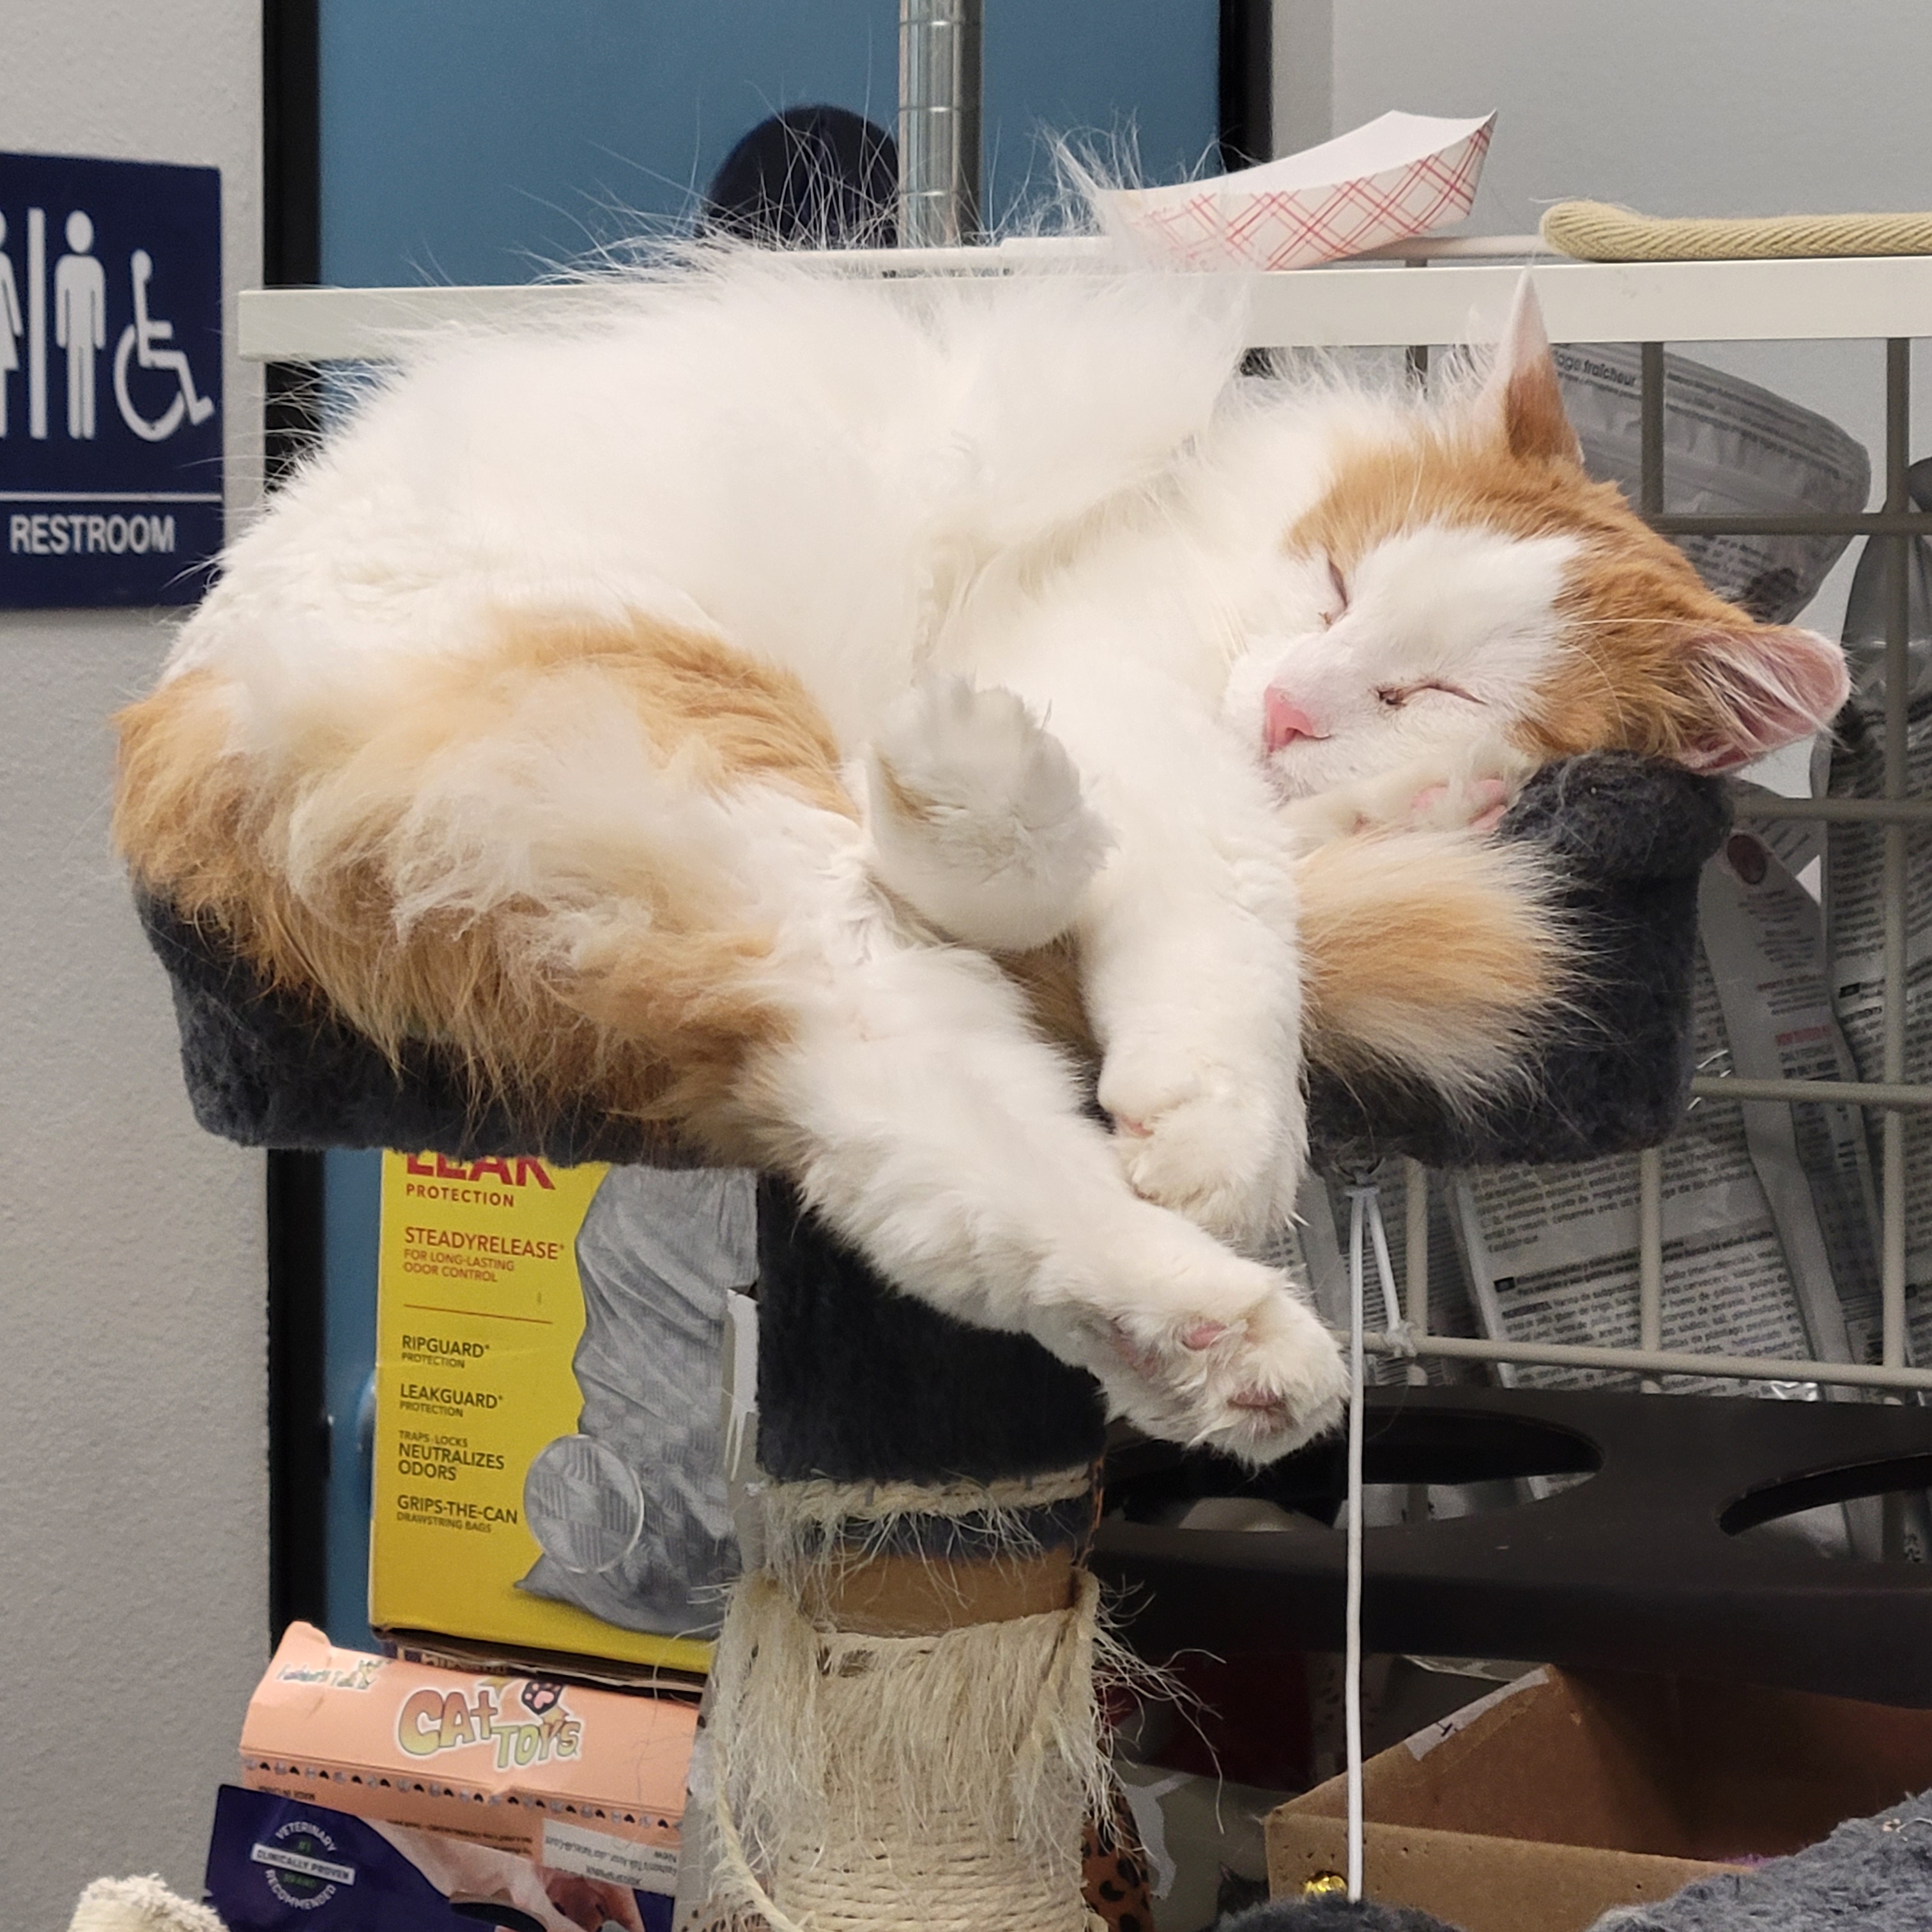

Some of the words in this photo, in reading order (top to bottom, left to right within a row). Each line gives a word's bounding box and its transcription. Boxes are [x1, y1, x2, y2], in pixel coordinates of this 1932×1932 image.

[10, 514, 176, 555] RESTROOM
[406, 1183, 514, 1207] PROTECTION
[404, 1249, 427, 1260] FOR
[431, 1252, 514, 1271] LONG-LASTING
[404, 1262, 438, 1275] ODOR
[441, 1266, 498, 1282] CONTROL
[401, 1352, 465, 1368] PROTECTION
[400, 1401, 463, 1417] PROTECTION
[434, 1436, 468, 1447] LOCKS
[399, 1443, 504, 1469] NEUTRALIZES
[398, 1460, 456, 1481] ODORS
[397, 1495, 518, 1524] GRIPS-THE-CAN
[397, 1512, 463, 1529] DRAWSTRING
[465, 1521, 491, 1533] BAGS
[491, 1721, 581, 1768] TOYS
[275, 1821, 337, 1851] VETERINARY
[257, 1850, 309, 1869] CLINICALLY
[310, 1863, 349, 1880] PROVEN
[265, 1869, 337, 1910] RECOMMENDED
